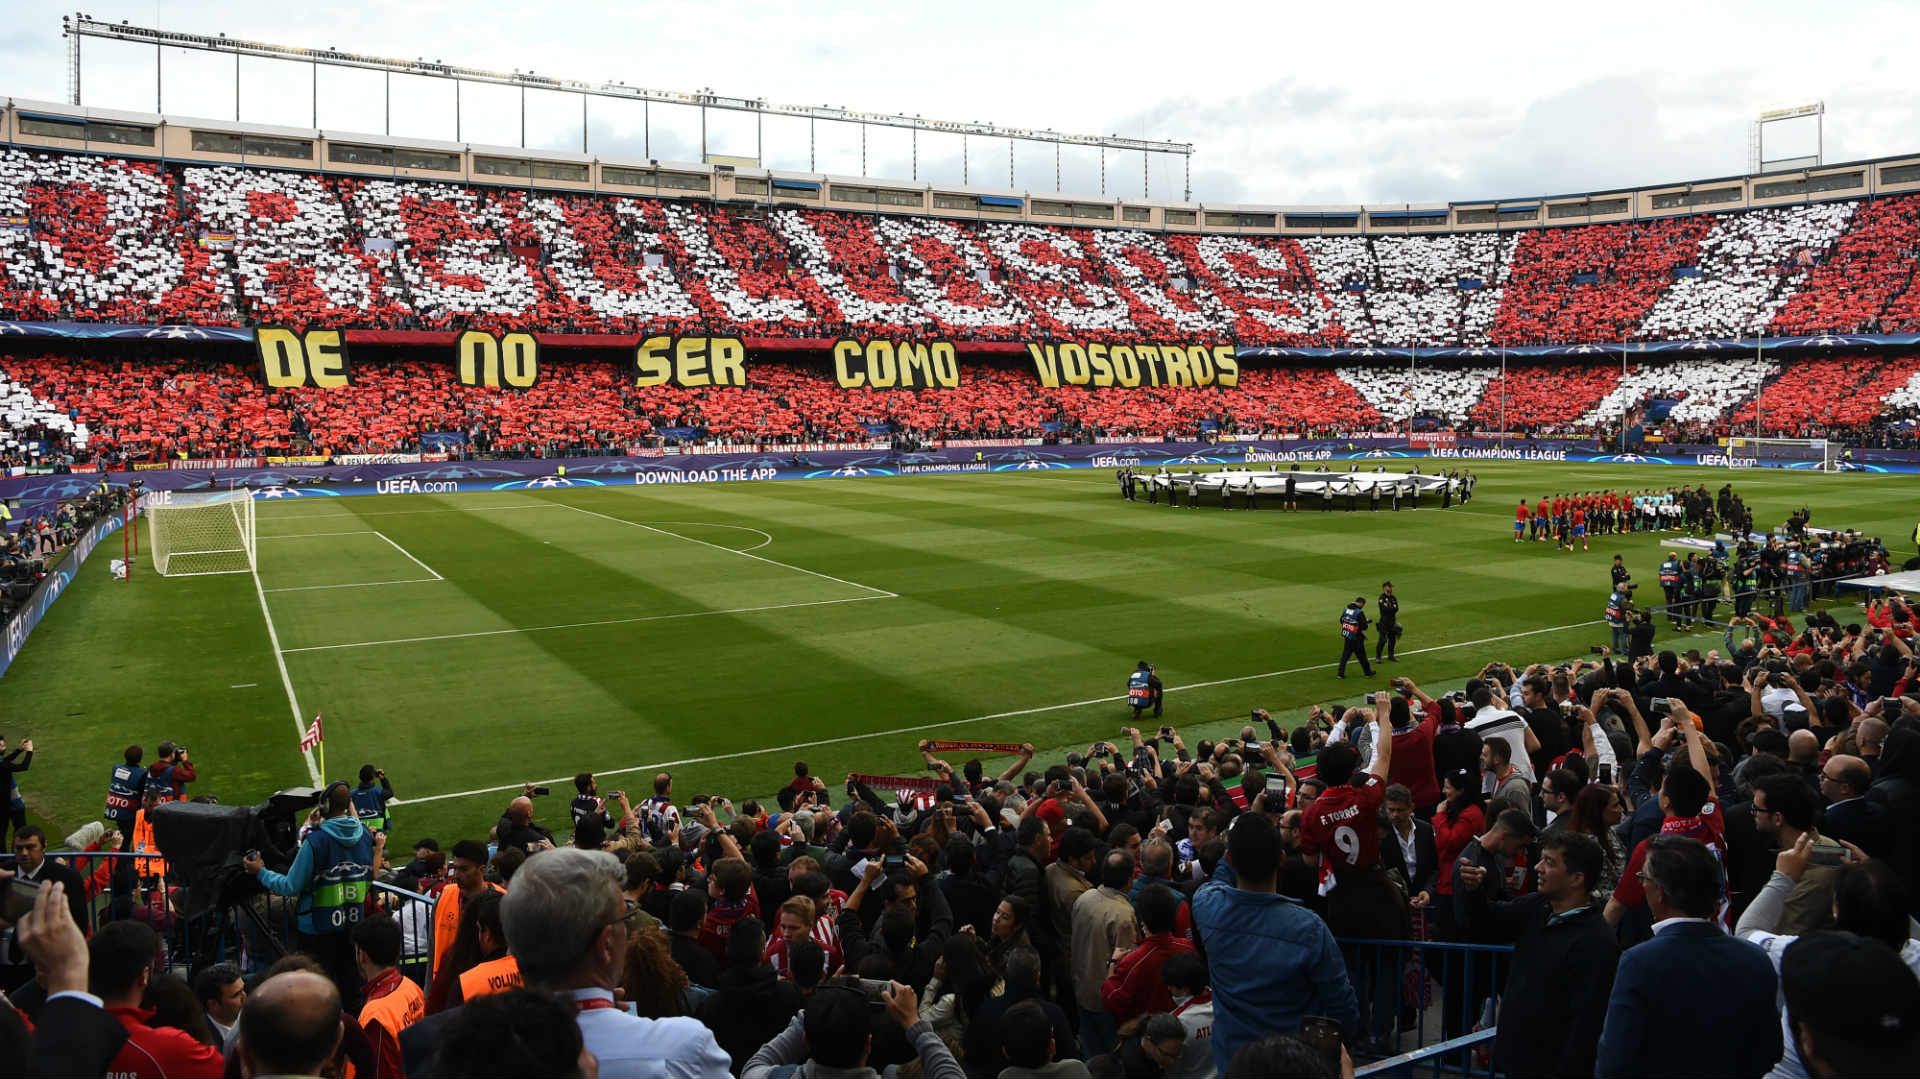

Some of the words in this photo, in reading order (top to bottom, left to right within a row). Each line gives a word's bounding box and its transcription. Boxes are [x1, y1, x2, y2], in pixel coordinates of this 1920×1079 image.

[258, 328, 349, 388] DE
[459, 331, 537, 388] NO
[635, 336, 746, 388] SER
[833, 339, 959, 388] COMO
[1026, 342, 1239, 388] VOSOTROS
[693, 443, 757, 455] MIGUELTURRA
[771, 443, 801, 453] SANTA
[806, 442, 822, 452] ANA
[1245, 451, 1296, 462] DOWNLOAD
[1297, 451, 1314, 461] THE
[1315, 450, 1332, 460] APP
[1431, 448, 1461, 458] UEFA
[1462, 449, 1521, 460] CHAMPIONS
[1525, 450, 1567, 461] LEAGUE
[901, 464, 921, 473] UEFA
[921, 462, 961, 472] CHAMPIONS
[963, 461, 987, 471] LEAGUE
[1092, 456, 1140, 468] UEFA.com
[635, 470, 719, 485] DOWNLOAD
[721, 469, 748, 481] THE
[751, 468, 777, 481] APP
[376, 480, 458, 494] UEFA.com
[1327, 804, 1360, 823] TORRES
[1334, 825, 1361, 865] 9
